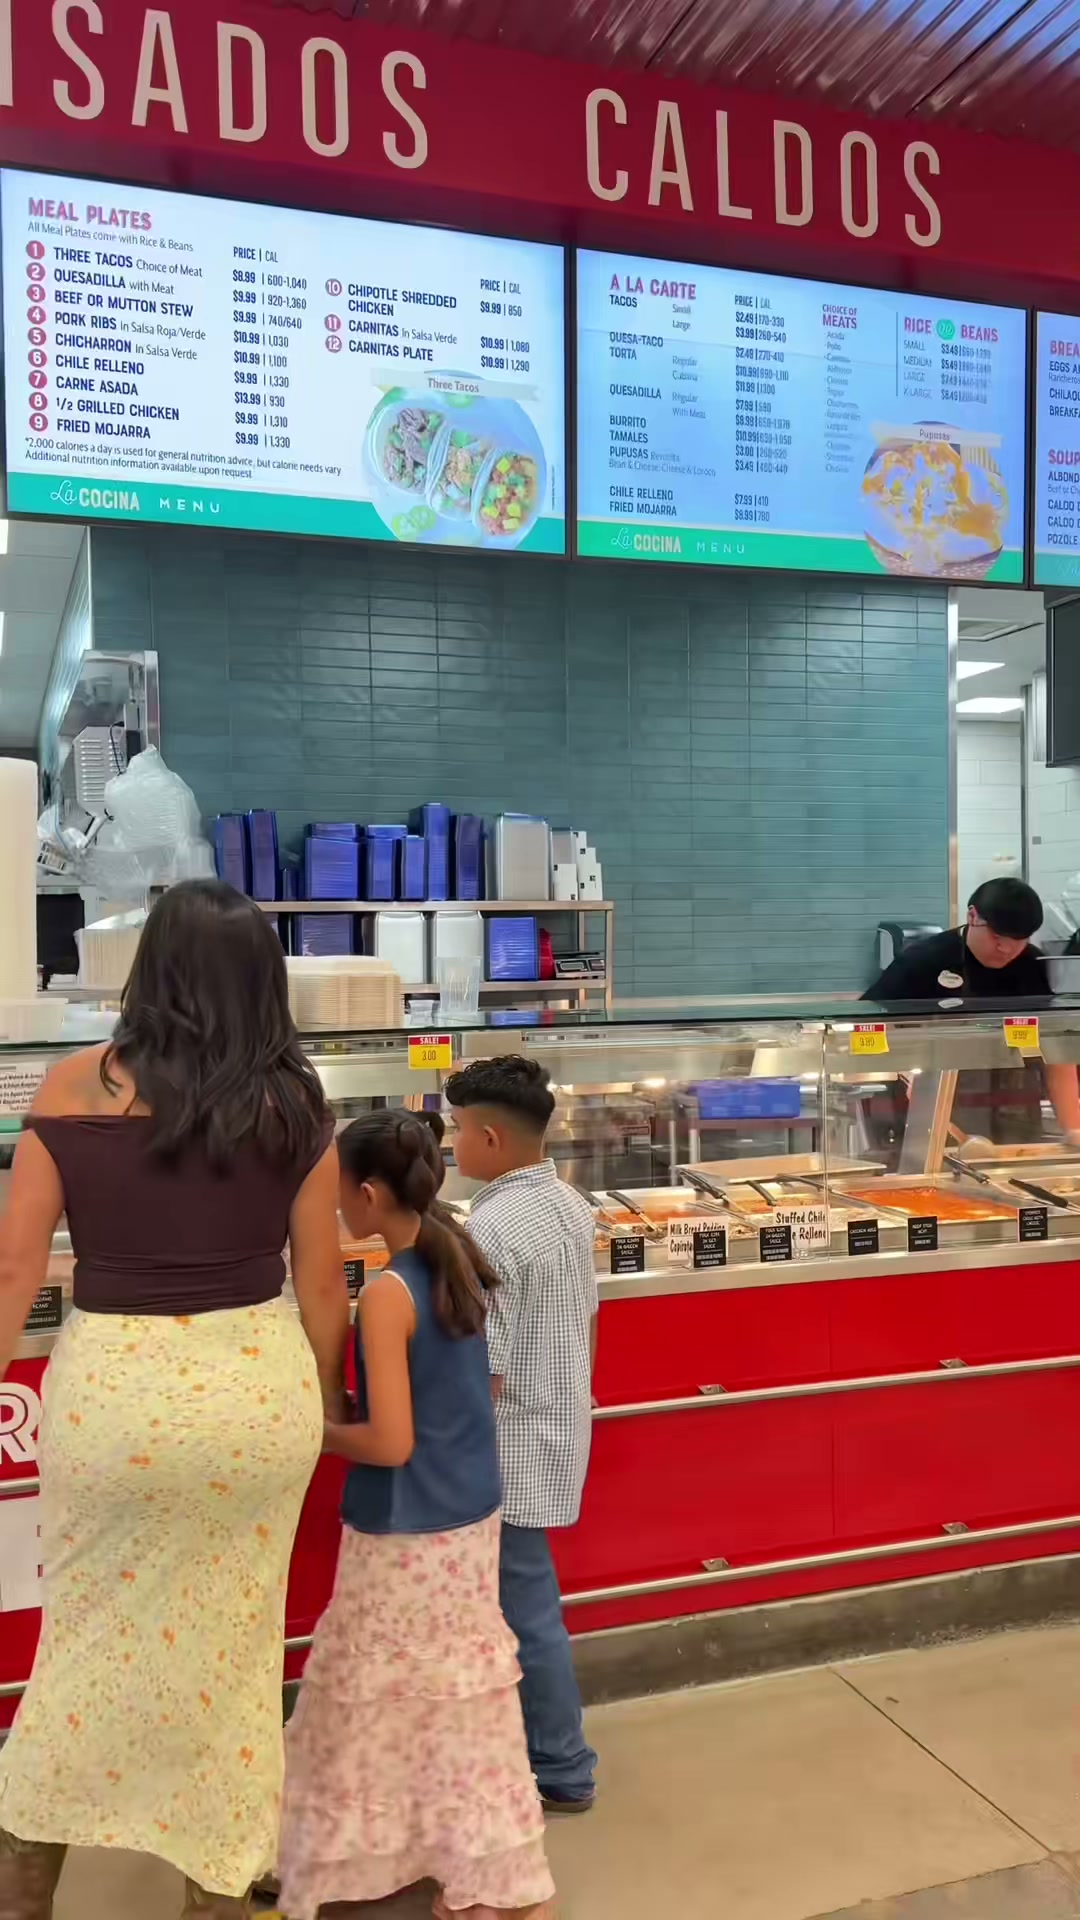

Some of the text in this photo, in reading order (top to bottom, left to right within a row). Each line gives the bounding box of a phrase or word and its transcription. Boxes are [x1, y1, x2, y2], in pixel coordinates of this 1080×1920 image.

[586, 88, 941, 246] CALDOS
[28, 197, 152, 231] MEAL PLATES
[28, 222, 194, 252] All Meal Plates come with Rice Beans
[54, 246, 202, 277] THREE TACOS Choice of Meat
[233, 246, 278, 263] PRICE CAL
[54, 268, 174, 294] QUESADILLA with Meat
[233, 269, 256, 283] $8.99
[480, 279, 521, 294] PRICE CAL
[610, 273, 696, 300] A LA CARTE
[55, 290, 194, 317] BEEF OR MUTTON STEW
[233, 290, 256, 304] $9.99
[348, 284, 457, 308] CHIPOTLE SHREDDED
[609, 294, 638, 308] TACOS
[735, 295, 753, 307] PRICE
[348, 299, 394, 316] CHICKEN
[480, 301, 522, 317] $9.99 850
[822, 304, 857, 316] CHOICE OF
[55, 311, 206, 340] PORK RIBS Salsa Roja/Verde
[233, 310, 302, 329] $9.99 740/640
[823, 314, 857, 329] MEATS
[234, 329, 259, 344] $10.99
[349, 319, 457, 344] CARNITAS Salsa Verde
[904, 317, 932, 334] RICE
[961, 324, 998, 342] BEANS
[56, 333, 197, 360] CHICHARRON Salsa Verde
[481, 336, 504, 350] $10.99
[610, 332, 663, 347] QUESA-TACO
[234, 350, 260, 365] $10.99
[349, 340, 433, 361] CARNITAS PLATE
[610, 347, 637, 360] TORTA
[56, 354, 144, 375] CHILE RELLENO
[481, 355, 504, 369] $10.99
[1049, 361, 1070, 373] EGGS
[234, 371, 257, 384] $9.99
[428, 378, 479, 393] Three Tacos
[56, 376, 138, 396] CARNE ASADA
[610, 384, 662, 400] QUESADILLA
[235, 391, 285, 407] $13.99 930
[56, 397, 179, 420] 1/2 GRILLED CHICKEN
[235, 411, 258, 425] $9.99
[610, 415, 646, 428] BURRITO
[57, 418, 151, 439] FRIED MOJARRA
[610, 430, 648, 443] TAMALES
[236, 432, 258, 445] $9.99
[56, 440, 341, 476] calories day used for general nutrition but calorie needs vary
[610, 446, 649, 459] PUPUSAS
[25, 450, 252, 479] Additional nutrition information available upon request
[50, 480, 220, 513] La COCINA MENU
[610, 486, 673, 501] CHILE RELLENO
[610, 501, 677, 517] FRIED MOJARRA
[1048, 499, 1074, 511] CALDO
[1048, 516, 1074, 528] CALDO
[611, 527, 745, 554] La COCINA MENU
[776, 1212, 805, 1223] Stuffed
